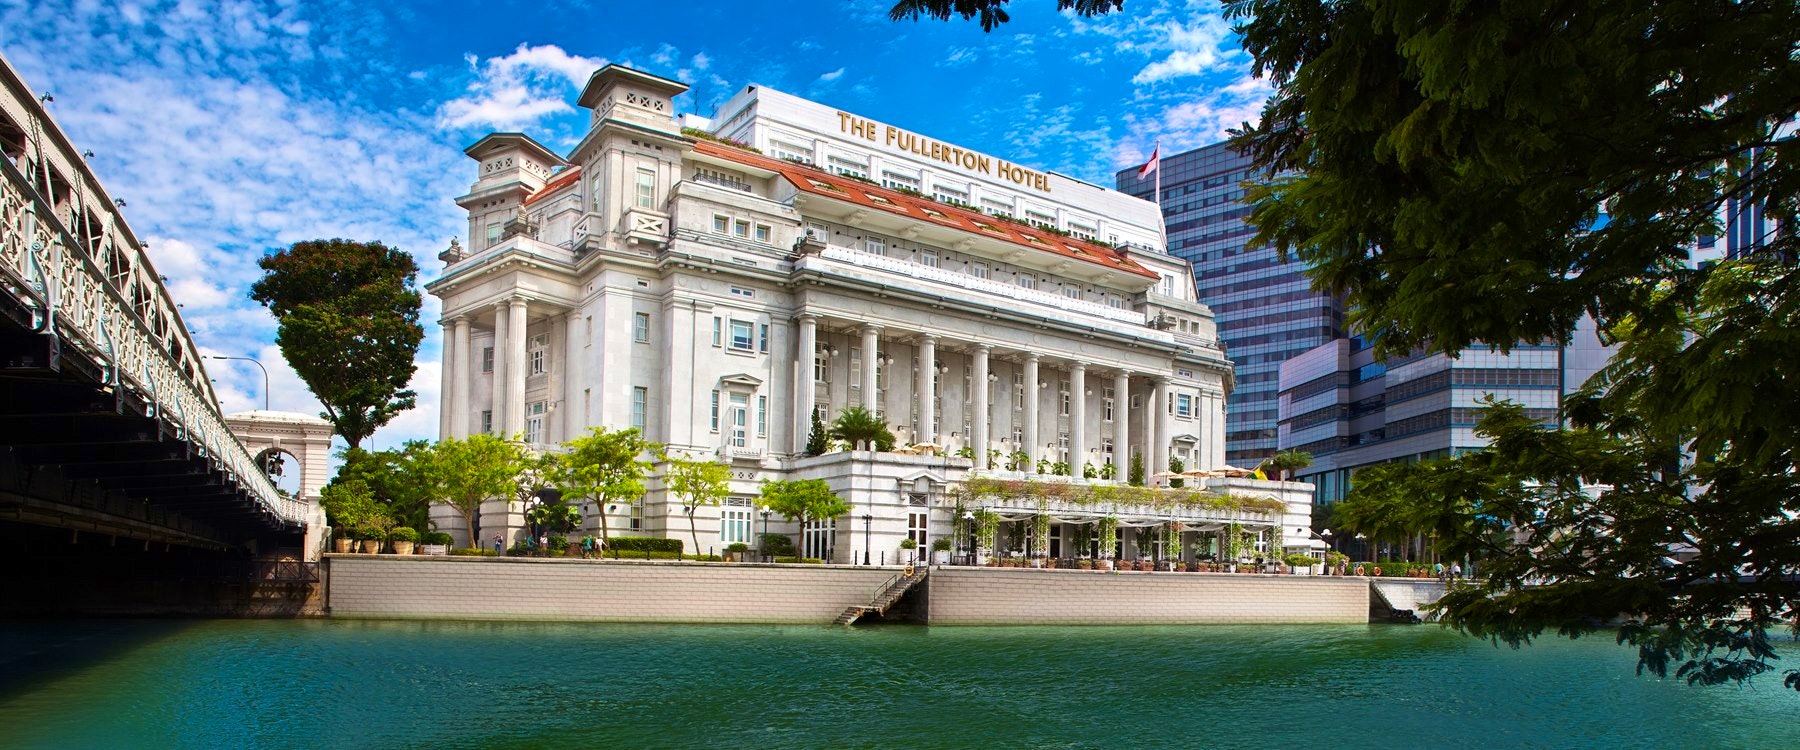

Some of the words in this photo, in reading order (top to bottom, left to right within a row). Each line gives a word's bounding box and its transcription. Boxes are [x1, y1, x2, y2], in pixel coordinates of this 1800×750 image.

[837, 111, 876, 140] THE
[886, 126, 990, 174] FULLERTON
[998, 160, 1052, 192] HOTEL
